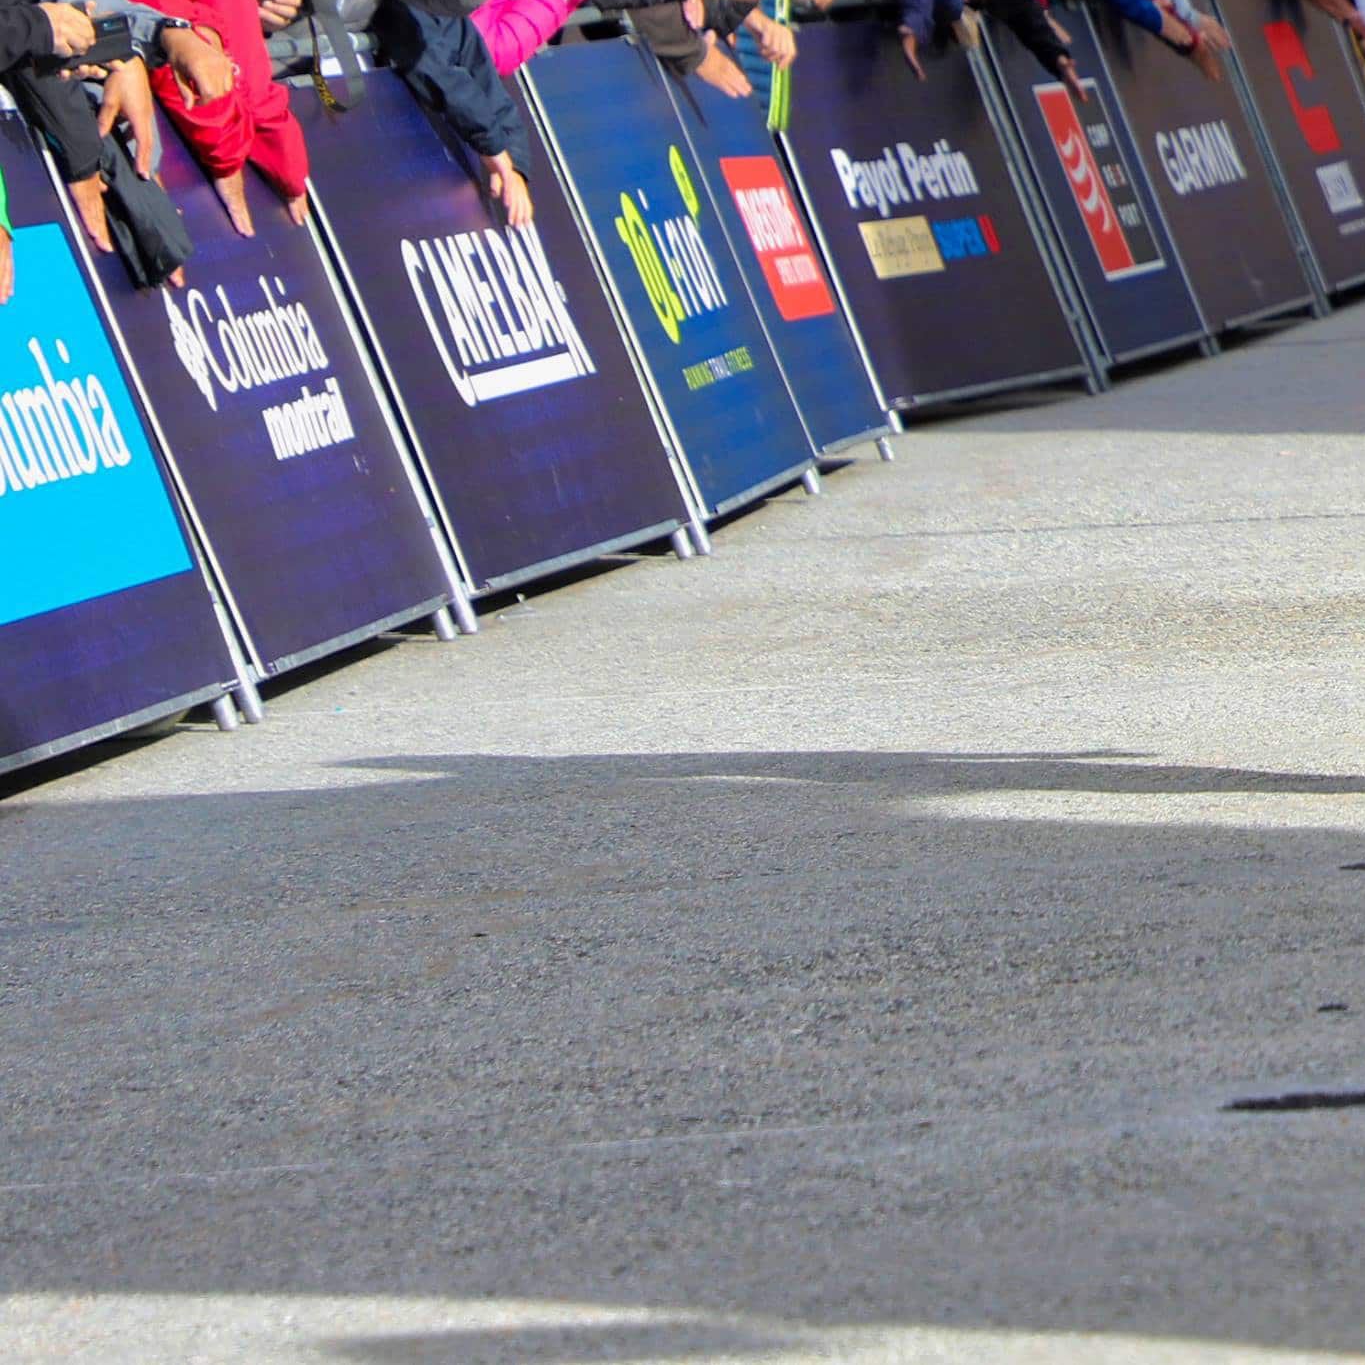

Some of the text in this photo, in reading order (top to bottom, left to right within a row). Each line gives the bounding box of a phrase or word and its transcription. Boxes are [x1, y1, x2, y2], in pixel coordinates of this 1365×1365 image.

[830, 139, 980, 218] Payot Pertin
[1155, 119, 1248, 195] GARMIN
[187, 276, 329, 394] Columbia
[401, 223, 597, 408] CAMELBAK
[262, 377, 355, 461] montrail
